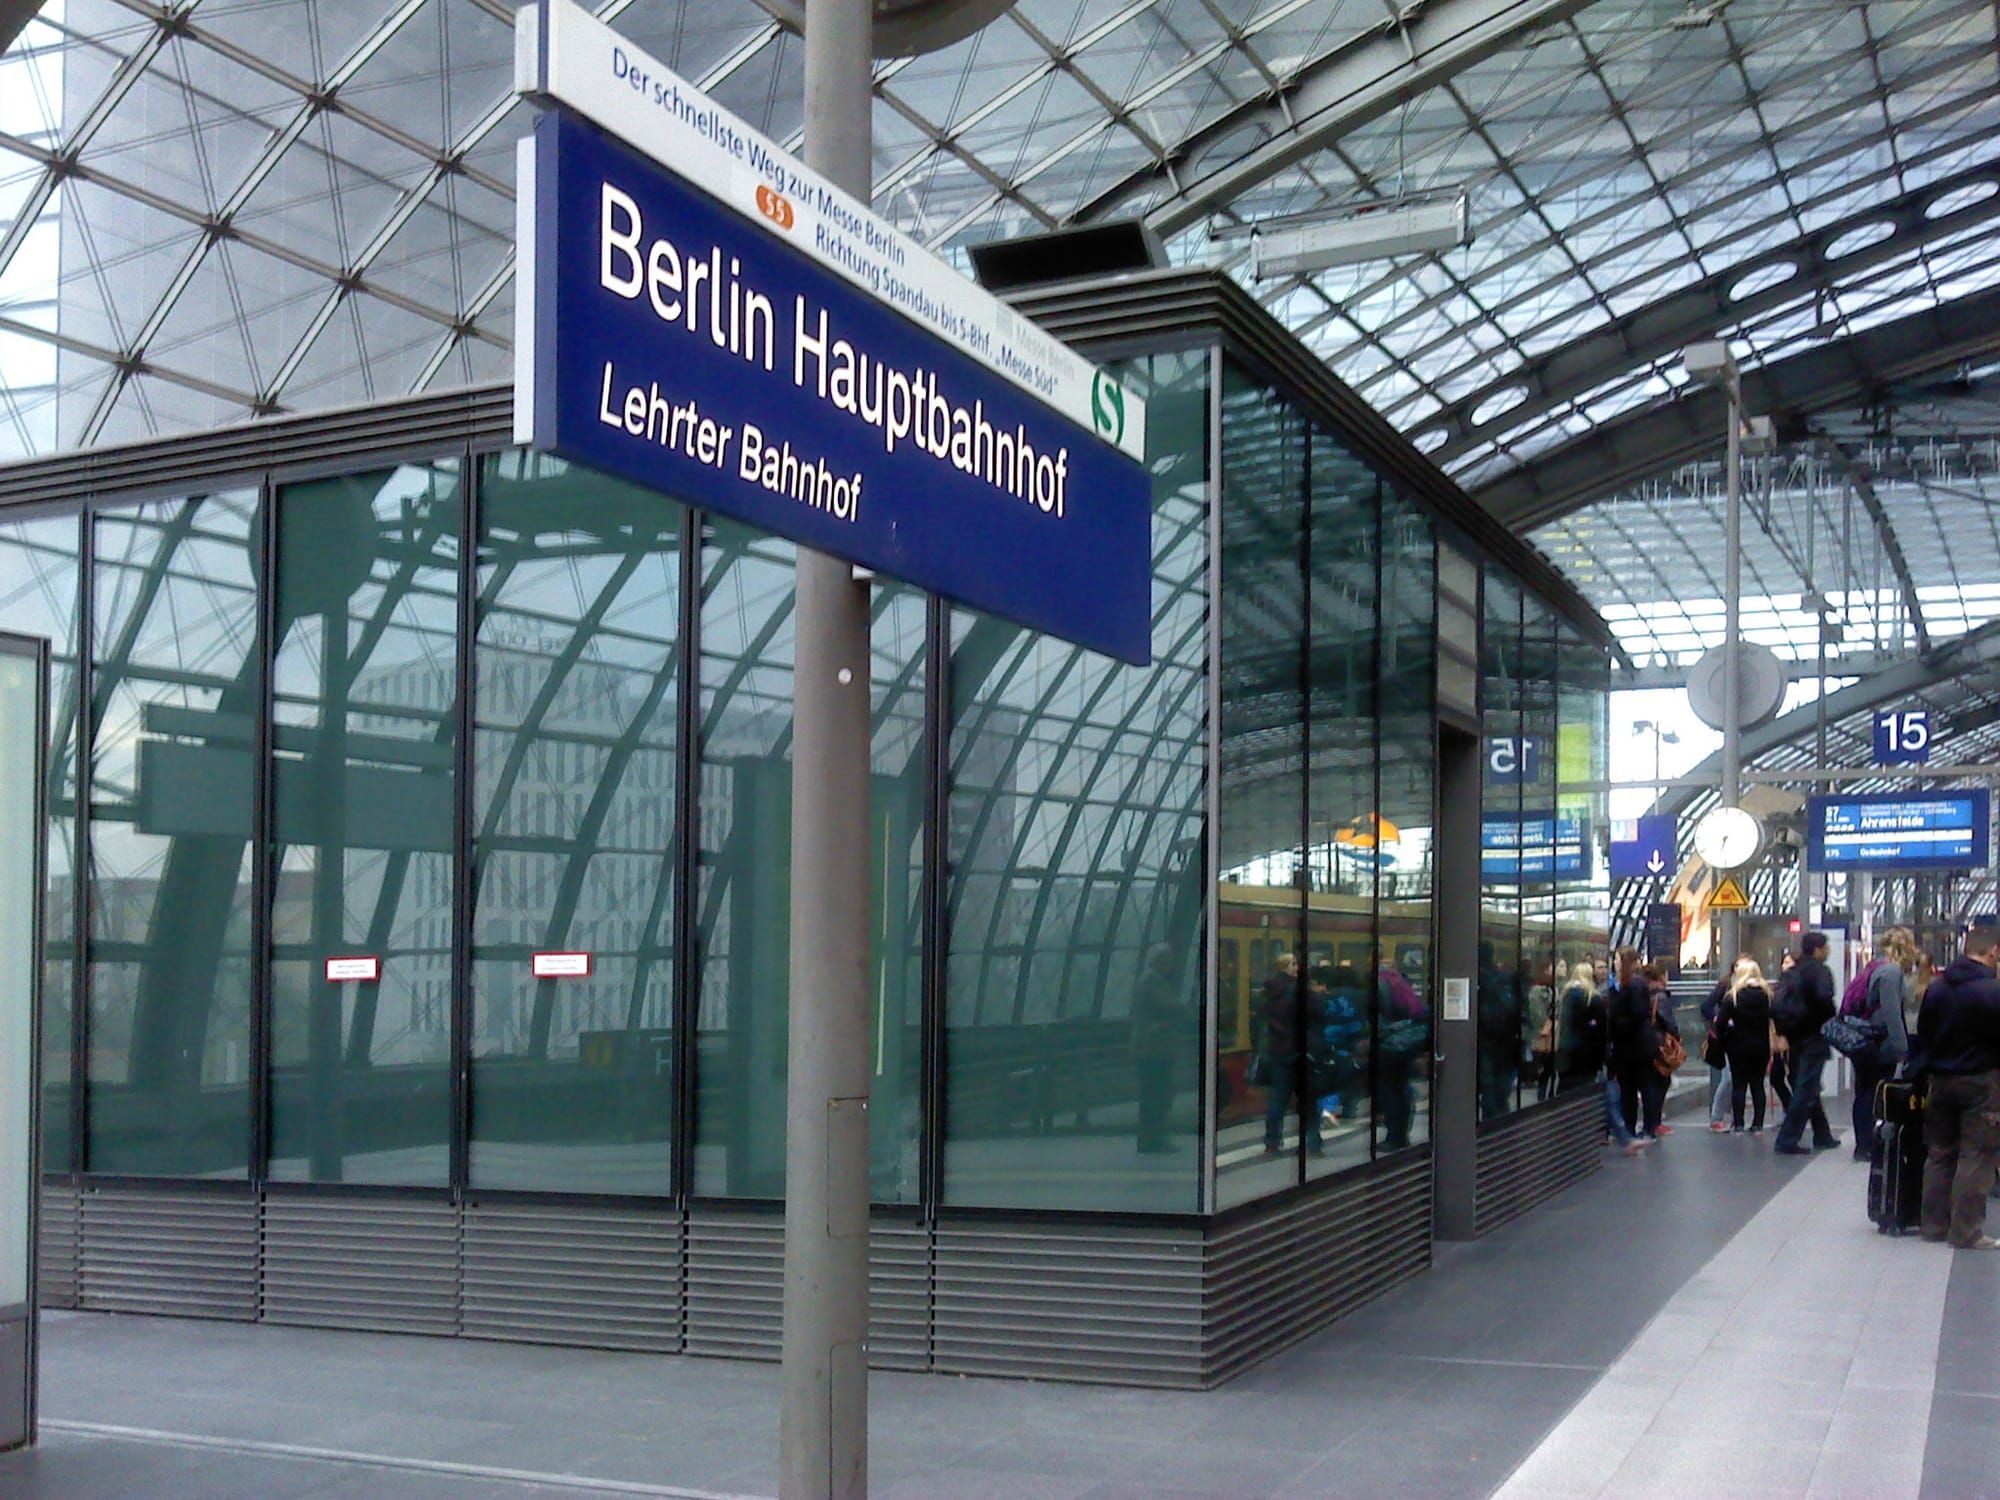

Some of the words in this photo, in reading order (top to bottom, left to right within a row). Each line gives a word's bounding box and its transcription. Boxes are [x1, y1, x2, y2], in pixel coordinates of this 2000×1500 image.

[613, 47, 648, 94] Der
[654, 85, 743, 160] schnellste
[748, 137, 786, 194] Weg
[789, 173, 814, 205] zur
[818, 187, 862, 239] Messe
[865, 220, 905, 268] Berlin
[764, 190, 787, 224] S5
[816, 223, 880, 291] Richtung
[883, 266, 939, 324] Spandau
[941, 301, 957, 336] bis
[600, 181, 775, 371] Berlin
[793, 294, 1068, 518] Hauptbahnhof
[1092, 368, 1125, 446] S
[599, 361, 732, 470] Lehrter
[739, 422, 862, 522] Bahnhof
[1880, 711, 1928, 751] 15
